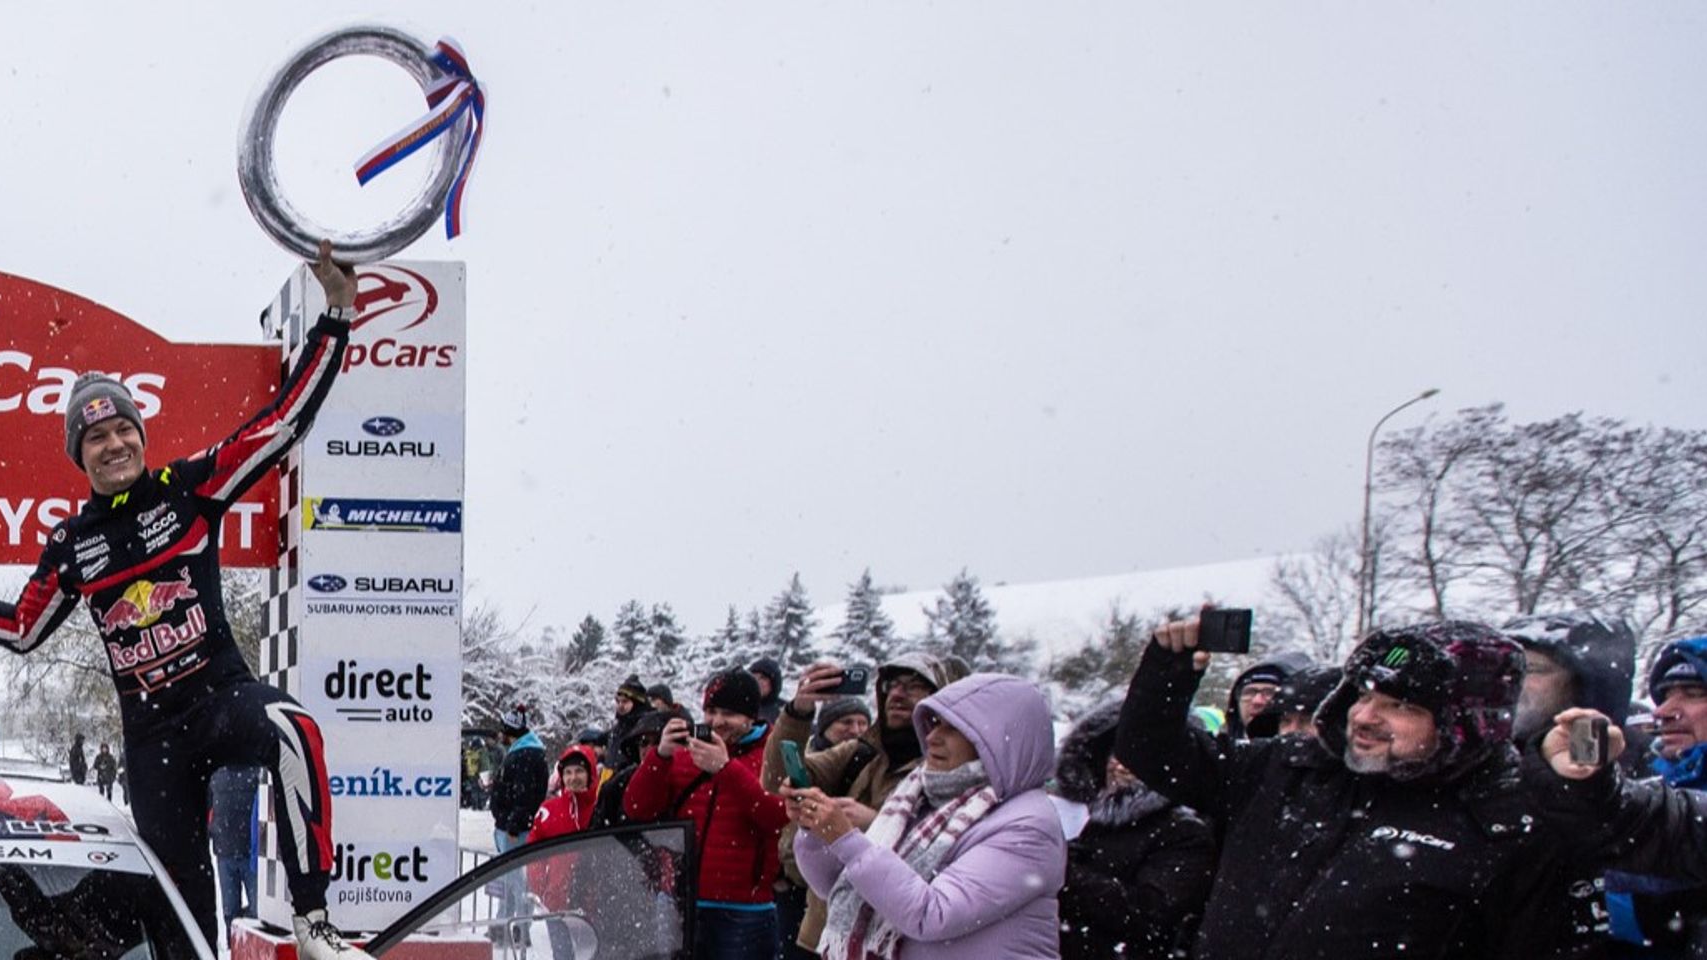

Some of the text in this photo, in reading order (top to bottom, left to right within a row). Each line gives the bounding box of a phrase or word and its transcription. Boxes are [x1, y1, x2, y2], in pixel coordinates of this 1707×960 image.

[341, 339, 457, 373] pCars
[326, 441, 435, 457] SUBARU
[137, 511, 177, 540] YACCO
[347, 510, 449, 523] MICHELIN
[354, 577, 454, 593] SUBARU
[307, 603, 455, 616] SUBARU MOTORS FINANCE
[107, 629, 156, 671] Red
[151, 602, 208, 655] Bull
[324, 660, 432, 700] direct
[385, 705, 433, 723] auto
[329, 767, 452, 797] eník.cz
[7, 820, 111, 836] LKQ
[1399, 829, 1456, 850] TipCars
